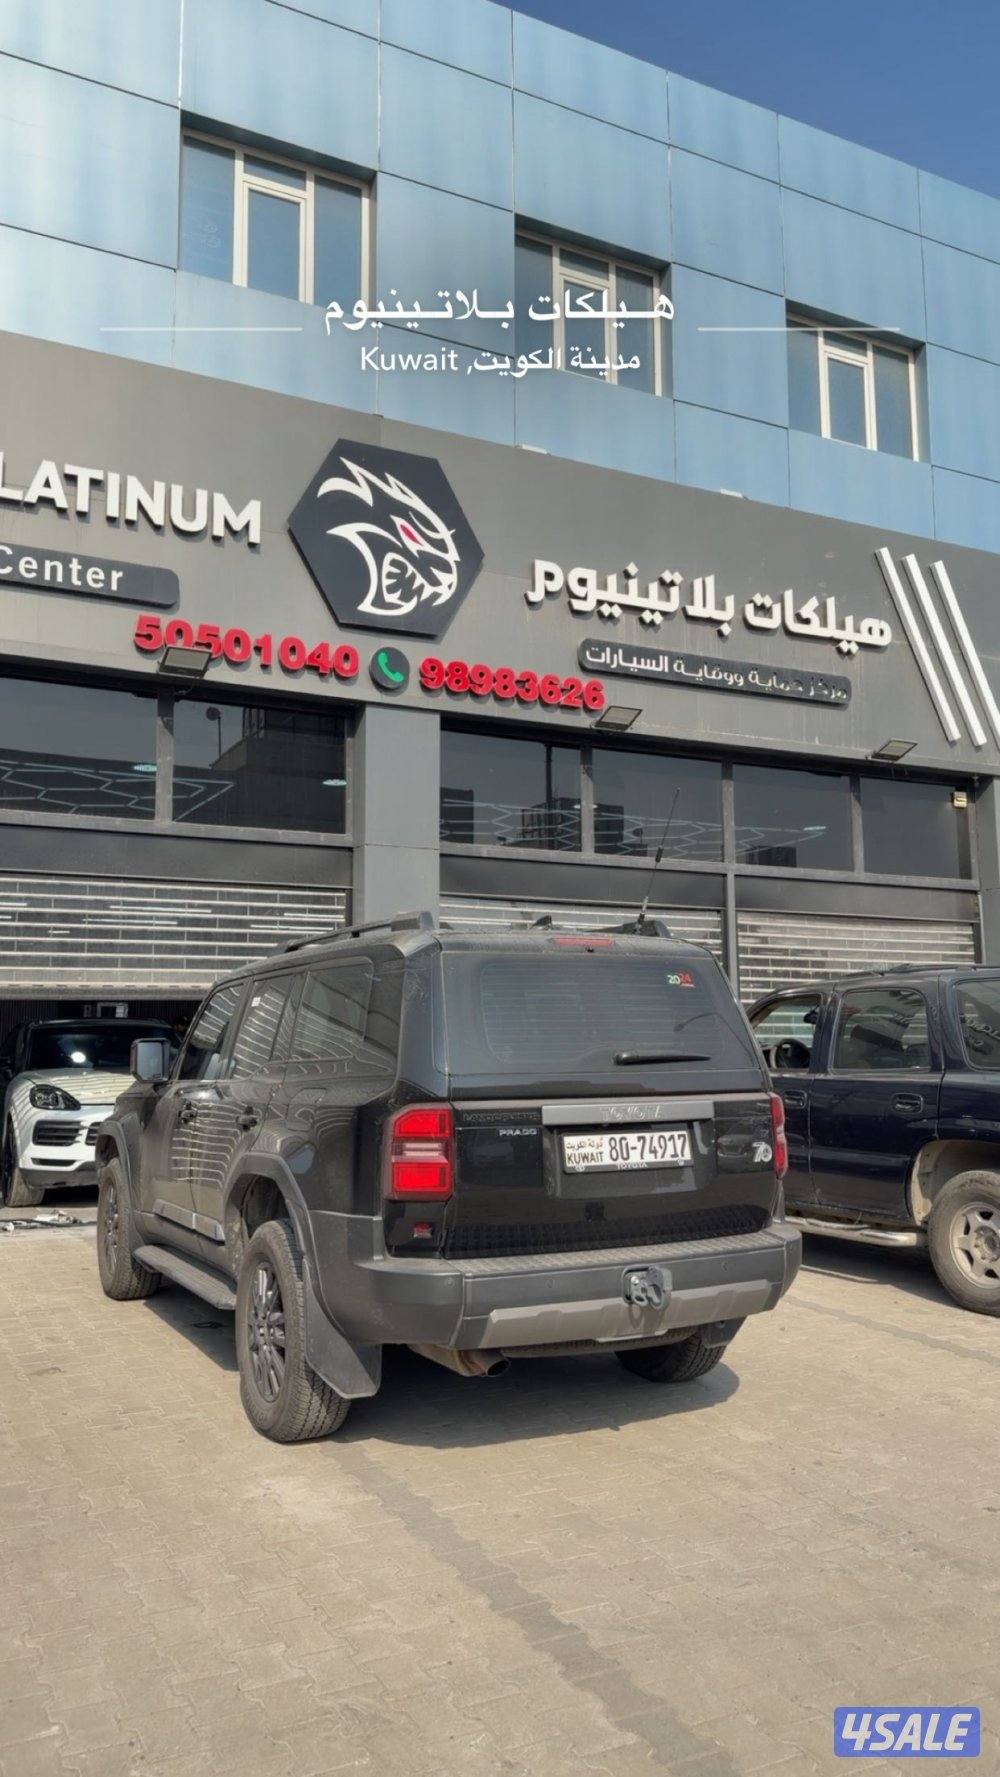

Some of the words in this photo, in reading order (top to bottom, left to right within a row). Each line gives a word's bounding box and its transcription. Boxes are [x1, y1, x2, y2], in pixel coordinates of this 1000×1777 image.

[524, 558, 736, 637] بلاتينيوم
[743, 588, 893, 655] هيلكات
[133, 614, 360, 679] 50501040
[418, 656, 606, 712] 98983626
[585, 645, 669, 674] السيارات
[672, 656, 744, 687] ووقاية
[566, 1151, 604, 1165] KUWAIT
[608, 1133, 687, 1162] 80-74917
[617, 1160, 649, 1170] TOYOTA
